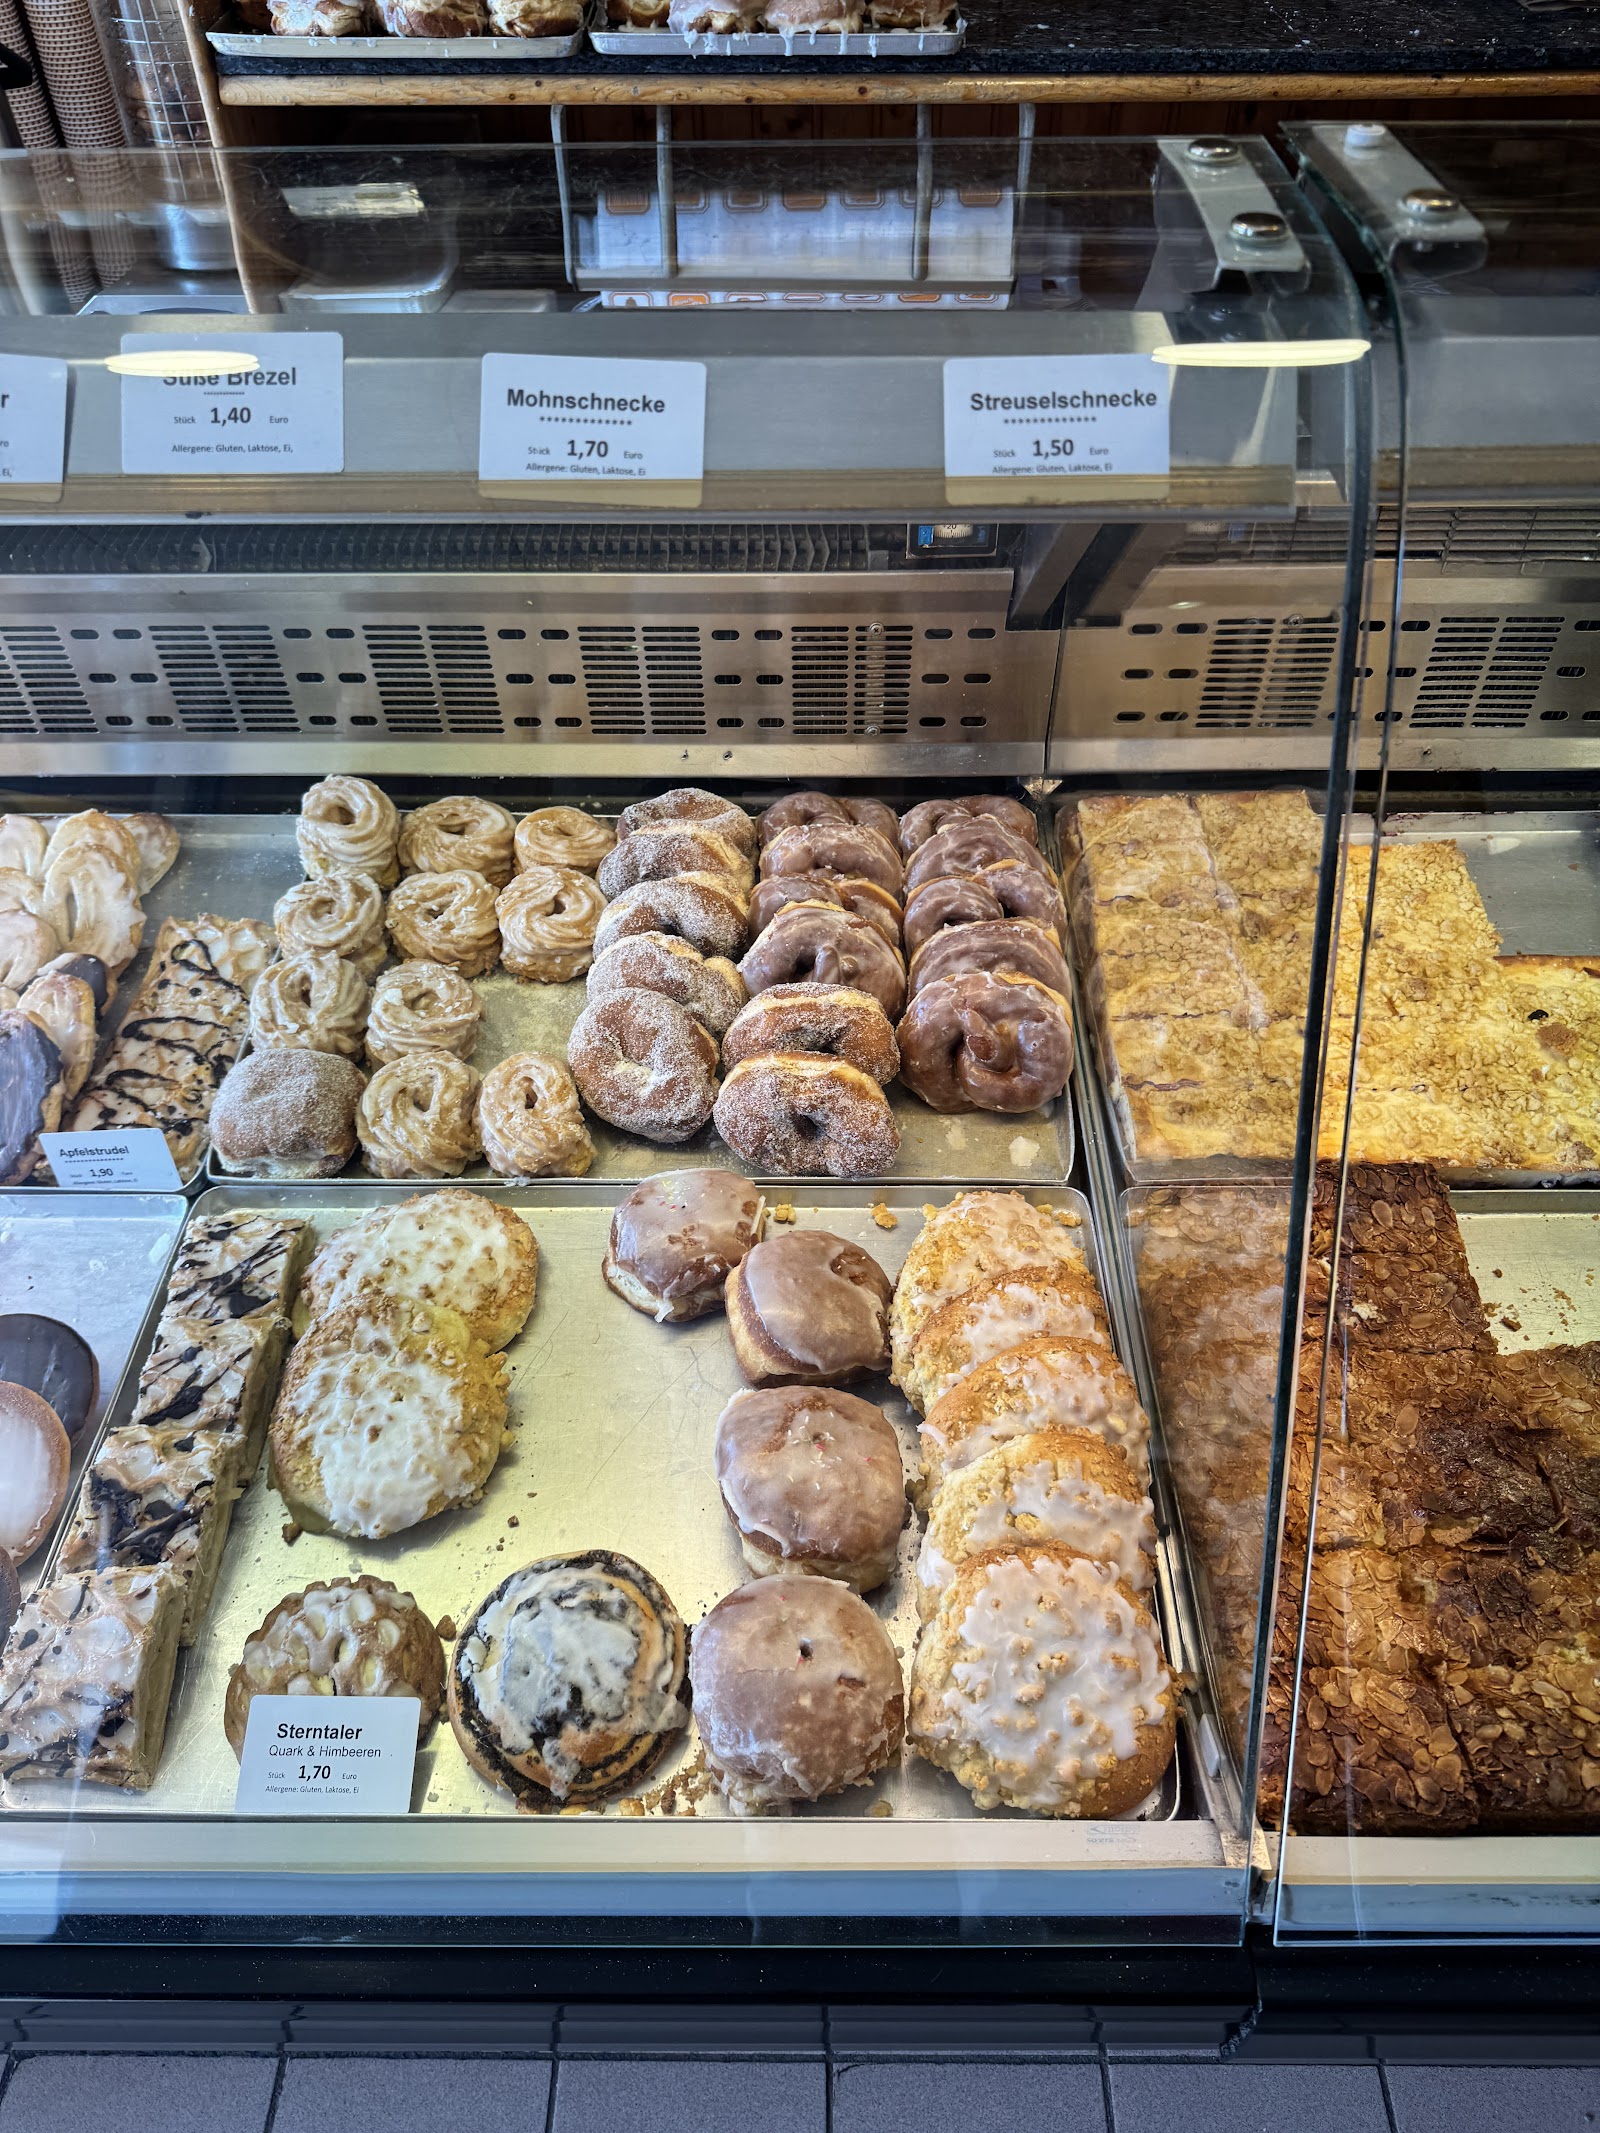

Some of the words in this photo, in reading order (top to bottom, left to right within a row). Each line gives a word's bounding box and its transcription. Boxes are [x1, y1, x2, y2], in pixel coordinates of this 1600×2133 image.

[228, 367, 297, 386] Brezel
[507, 389, 666, 413] Mohnschnecke
[970, 388, 1157, 411] Streuselschnecke
[173, 415, 196, 425] Stück
[210, 407, 251, 427] 1,40
[269, 415, 289, 424] Euro
[172, 444, 214, 454] Allergene:
[215, 444, 246, 453] Gluten,
[247, 444, 281, 453] Laktose,
[567, 440, 609, 460] 1,70
[624, 451, 643, 460] Euro
[993, 449, 1016, 458] Stück
[1032, 439, 1074, 460] 1,50
[1089, 447, 1109, 456] Euro
[526, 463, 568, 473] Allergene:
[570, 464, 600, 475] Gluten,
[992, 466, 1034, 475] Allergene:
[1037, 464, 1067, 474] Gluten,
[60, 1146, 130, 1158] Apfelstrudel
[90, 1168, 114, 1178] 1,90
[277, 1723, 363, 1740] Sterntaler
[269, 1745, 303, 1757] Quark
[307, 1745, 315, 1757] &
[319, 1745, 381, 1758] Himbeeren
[298, 1765, 331, 1782] 1,70
[265, 1785, 299, 1794] Allergene:
[300, 1785, 324, 1794] Gluten,
[325, 1786, 351, 1795] Laktose,
